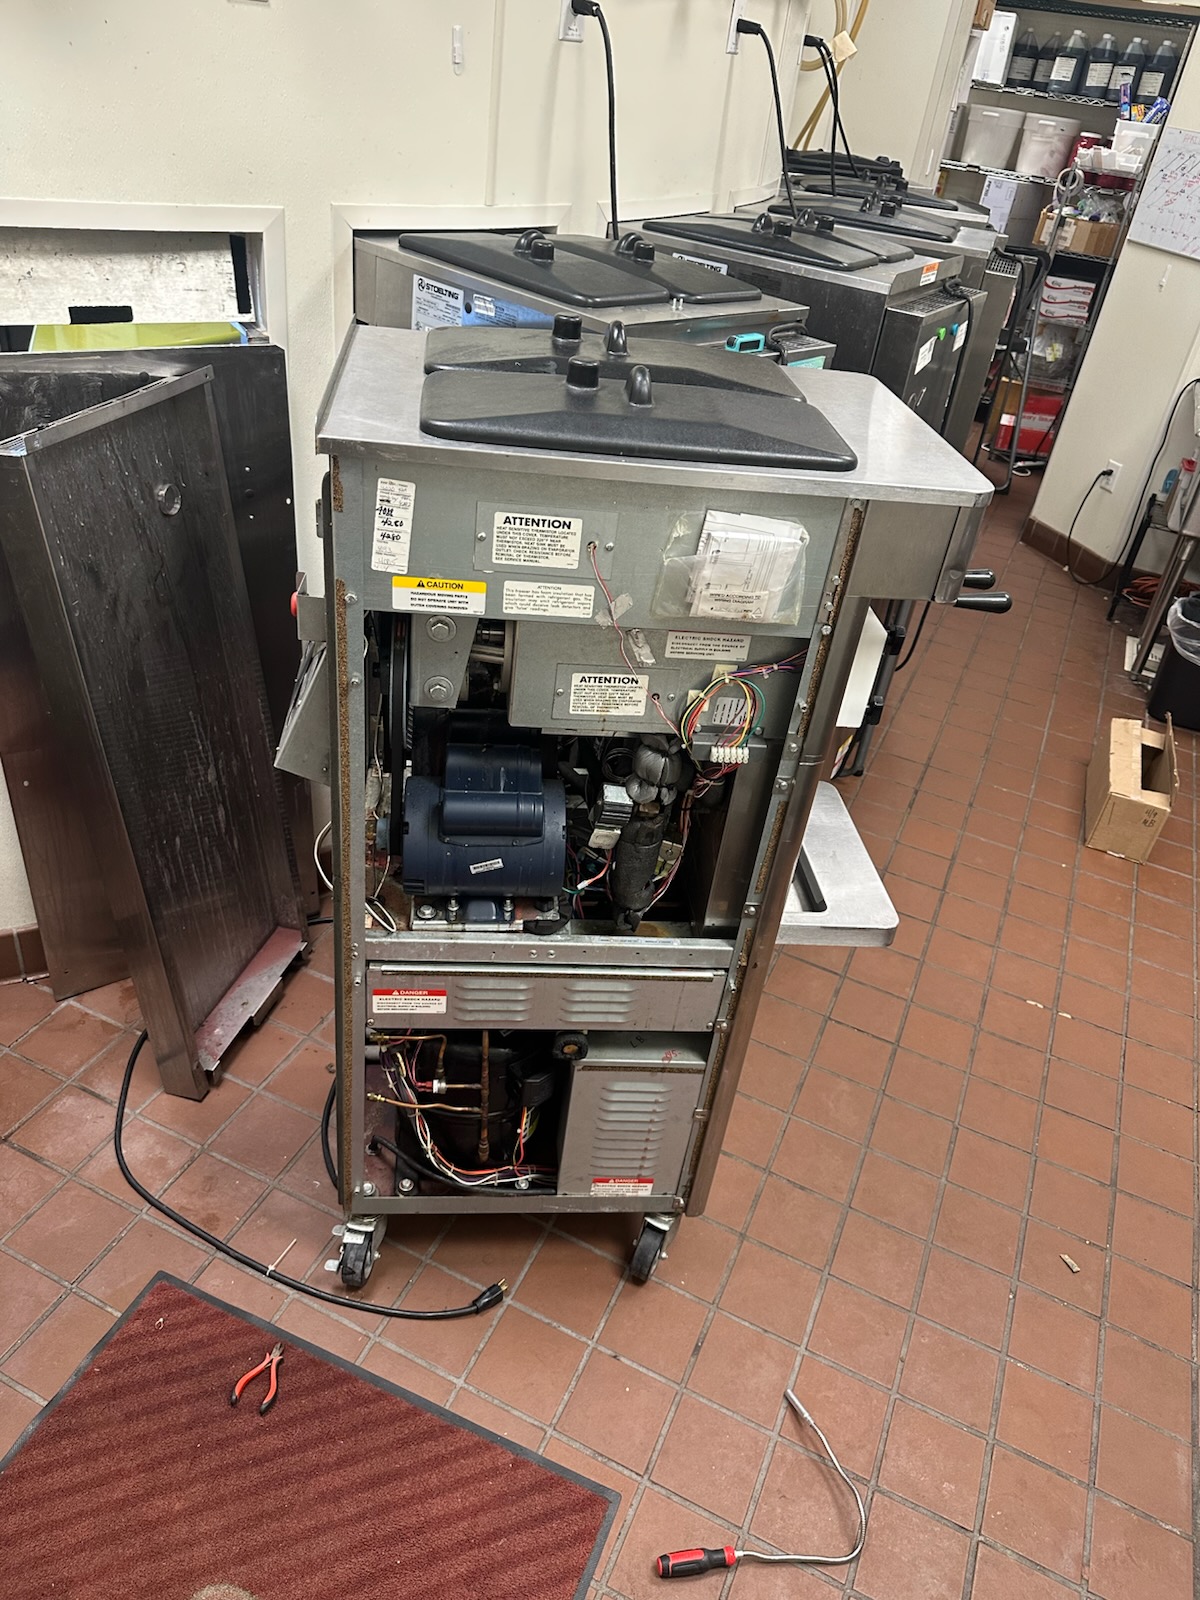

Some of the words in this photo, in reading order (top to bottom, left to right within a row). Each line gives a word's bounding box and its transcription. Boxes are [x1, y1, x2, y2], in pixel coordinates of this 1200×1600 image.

[425, 282, 459, 300] STOELTING
[503, 516, 571, 529] ATTENTION
[427, 581, 463, 589] CAUTION
